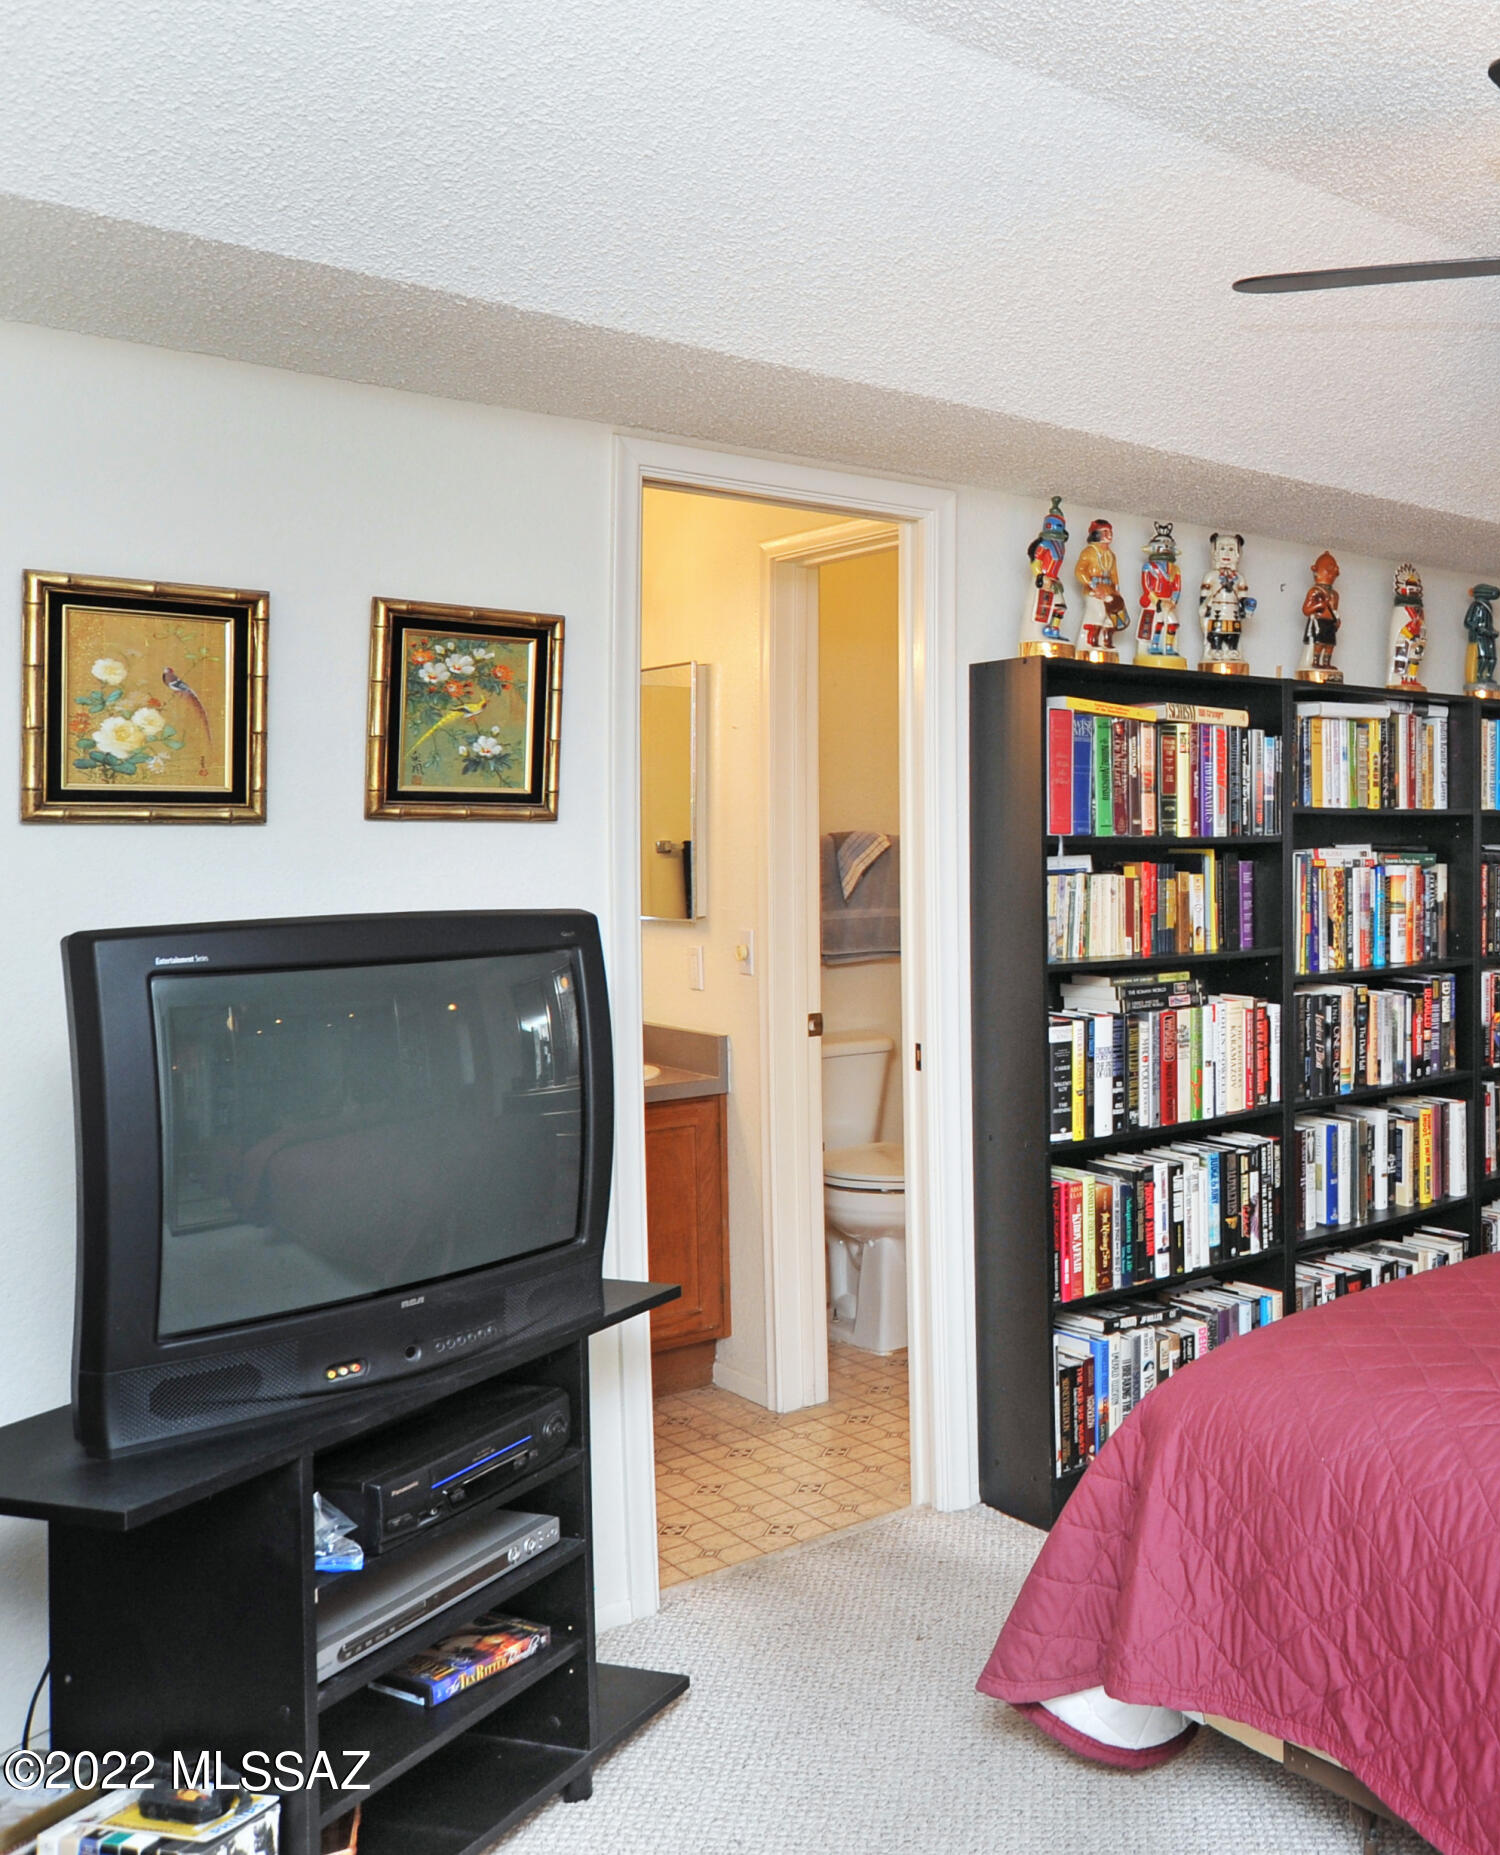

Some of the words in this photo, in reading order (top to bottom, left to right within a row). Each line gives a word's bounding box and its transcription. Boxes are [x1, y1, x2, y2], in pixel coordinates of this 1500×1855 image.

[1168, 702, 1195, 721] SCHISM
[1333, 1026, 1341, 1048] ONE
[401, 1296, 425, 1309] RCA
[1122, 1364, 1132, 1400] BREAKING
[458, 1671, 476, 1690] TEX
[476, 1657, 508, 1682] RITTER
